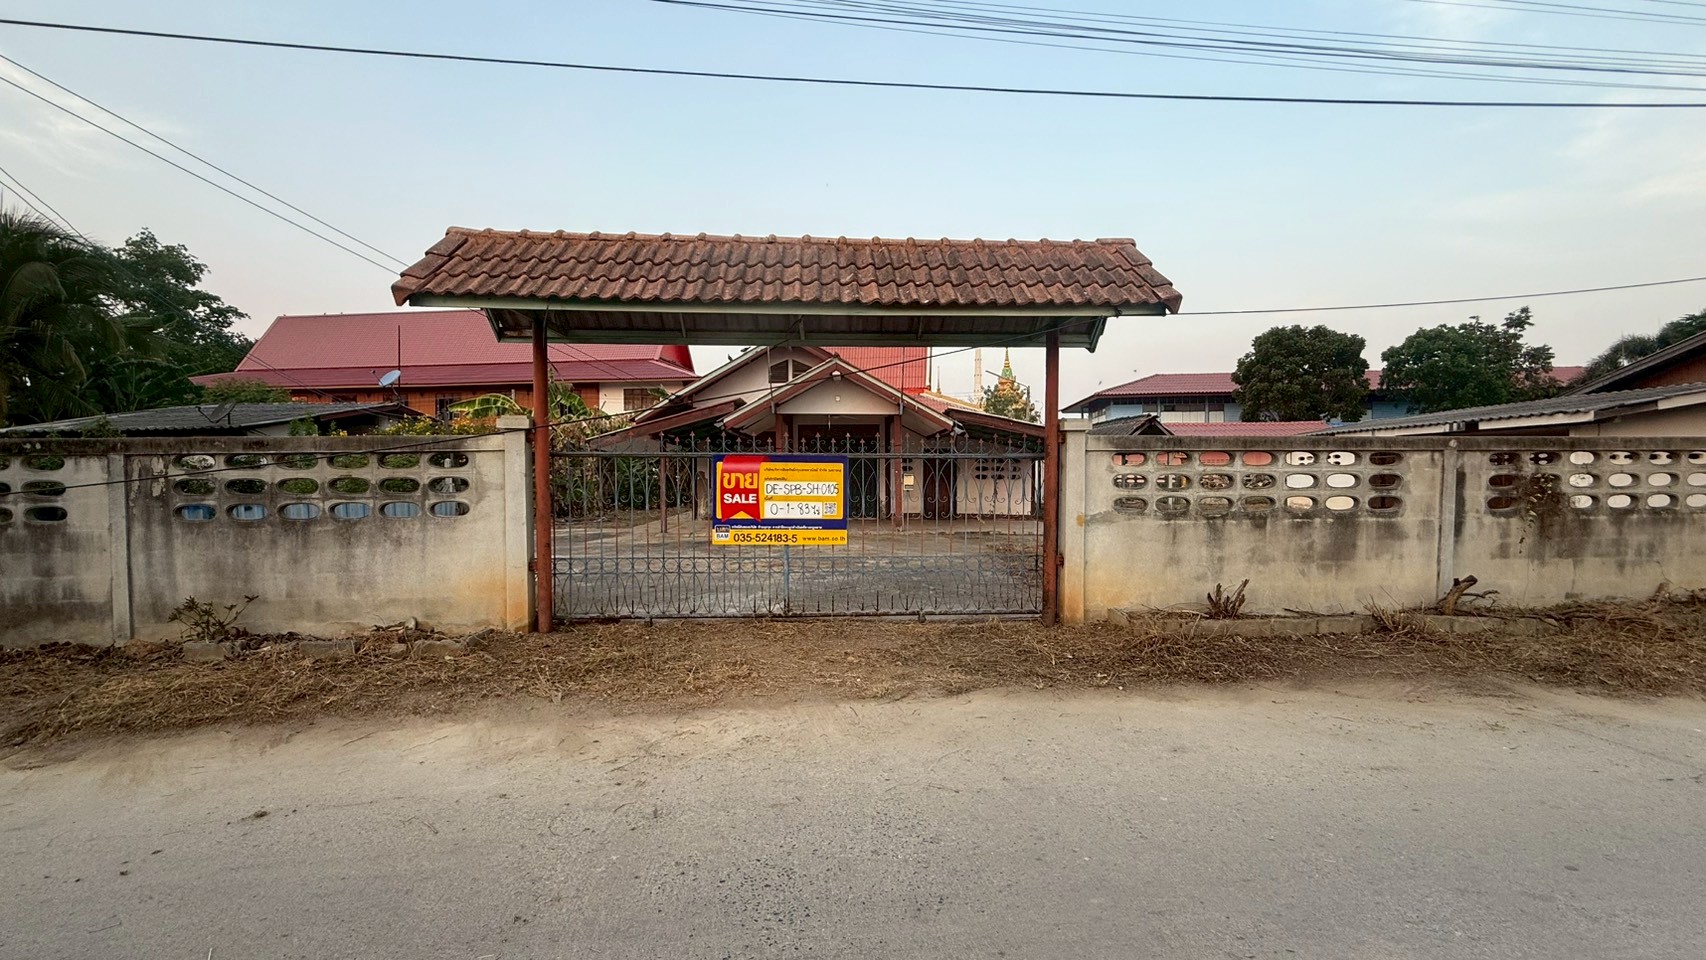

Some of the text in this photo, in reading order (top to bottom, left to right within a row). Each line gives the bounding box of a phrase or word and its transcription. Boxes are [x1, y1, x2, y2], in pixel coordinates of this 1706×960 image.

[723, 472, 758, 489] ขาย
[723, 493, 757, 504] SALE
[733, 533, 798, 543] 035-524183-5
